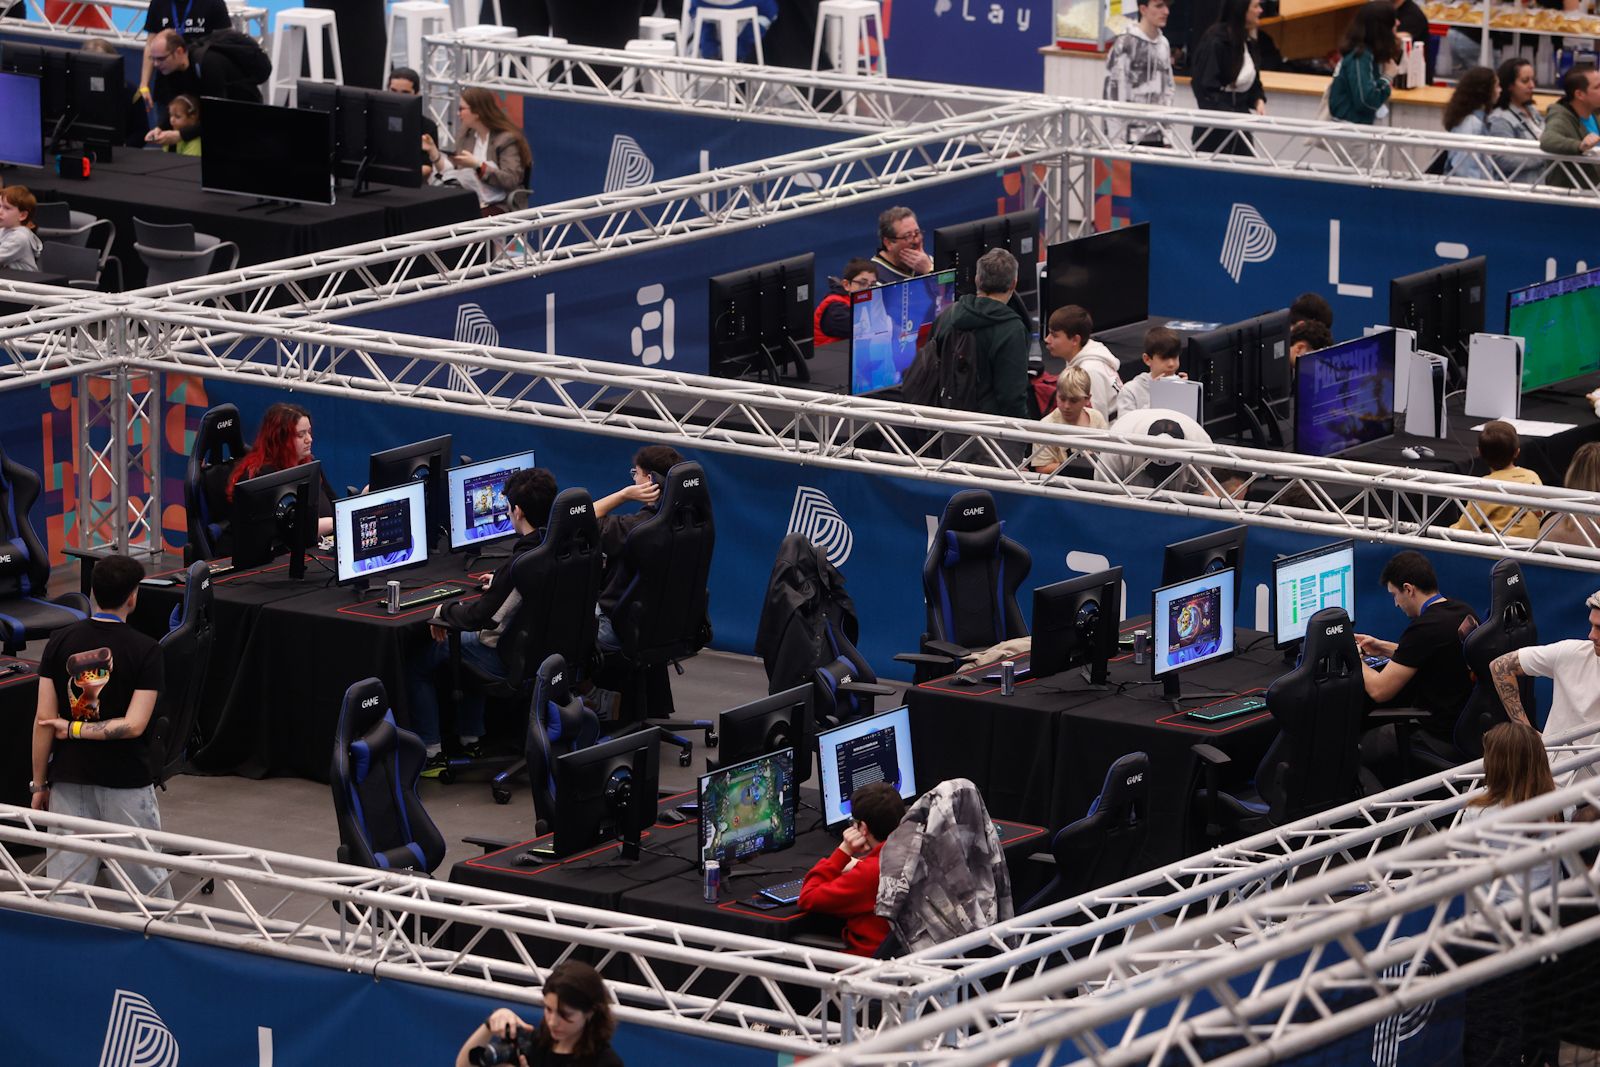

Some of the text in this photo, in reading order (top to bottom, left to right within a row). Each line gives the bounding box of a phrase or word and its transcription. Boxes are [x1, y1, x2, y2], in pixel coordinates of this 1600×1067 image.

[216, 418, 233, 430] GAME
[682, 477, 700, 489] GAME
[569, 504, 587, 516] GAME
[962, 506, 985, 517] GAME
[0, 554, 12, 564] ME
[1506, 573, 1520, 586] GAME
[1325, 624, 1344, 636] GAME
[361, 695, 379, 709] GAME
[1126, 772, 1143, 786] GAME
